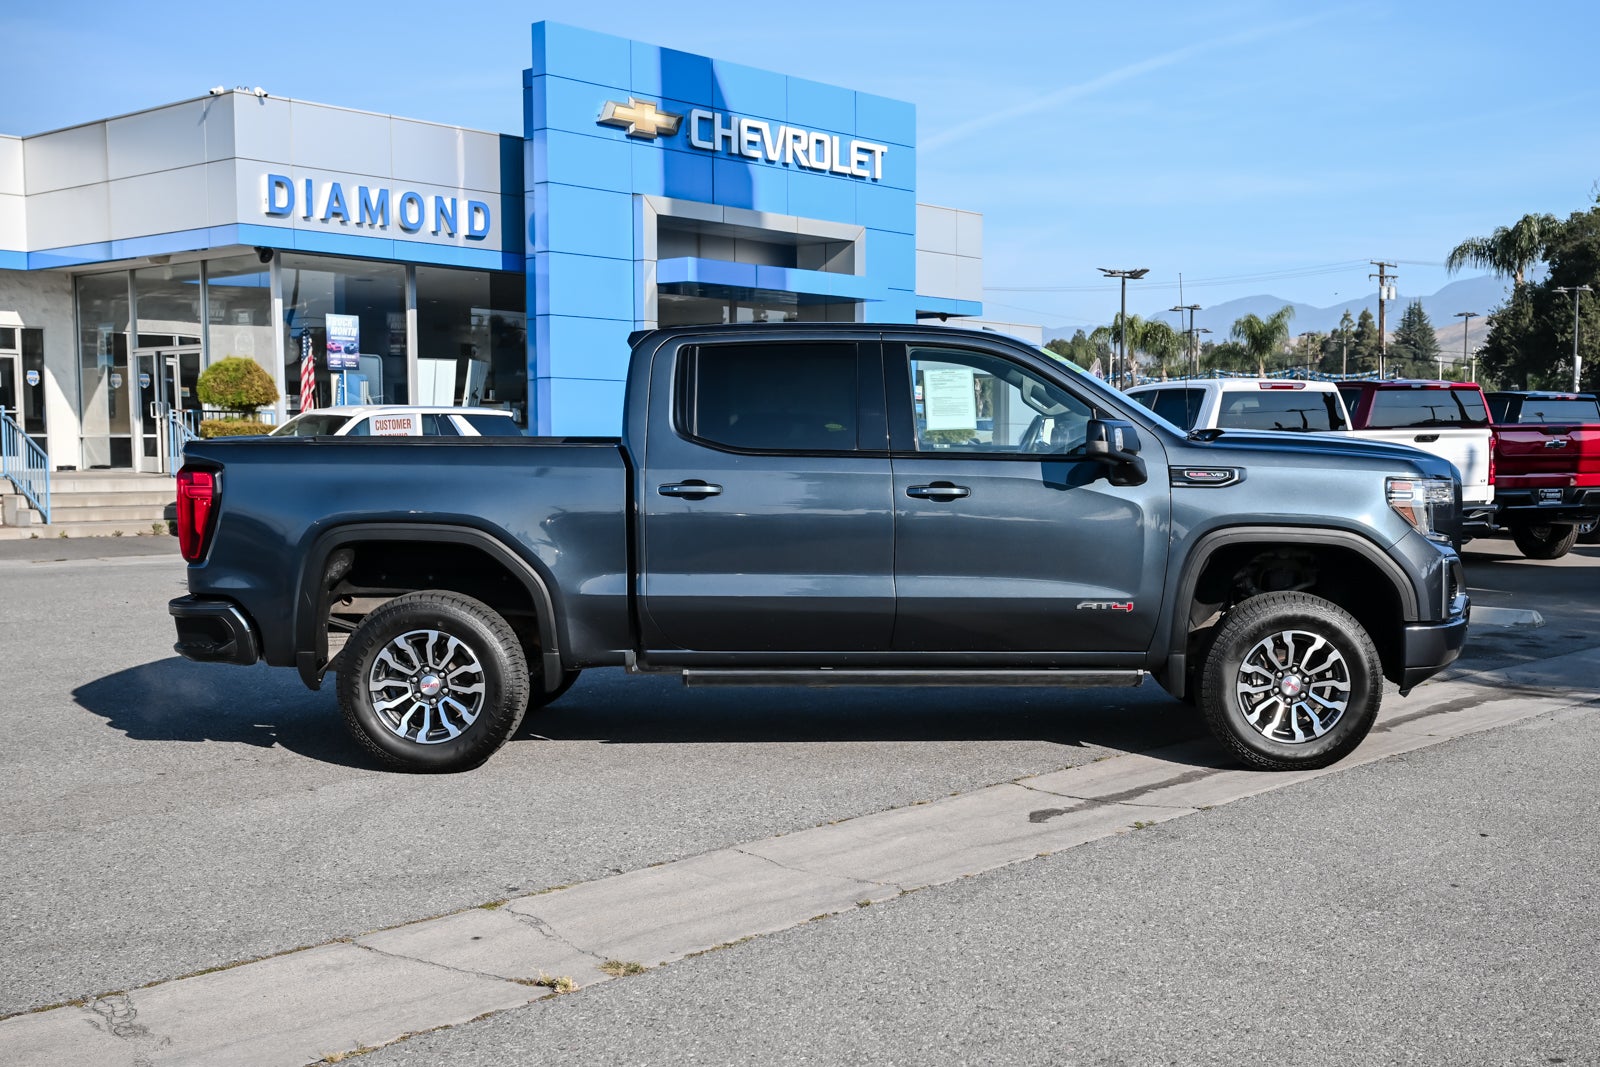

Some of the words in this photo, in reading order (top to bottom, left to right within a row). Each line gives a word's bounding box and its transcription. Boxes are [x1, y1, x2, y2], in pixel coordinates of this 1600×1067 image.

[689, 108, 888, 181] CHEVROLET
[264, 174, 491, 240] DIAMOND
[375, 419, 411, 431] CUSTOMER
[1076, 601, 1134, 613] AT4
